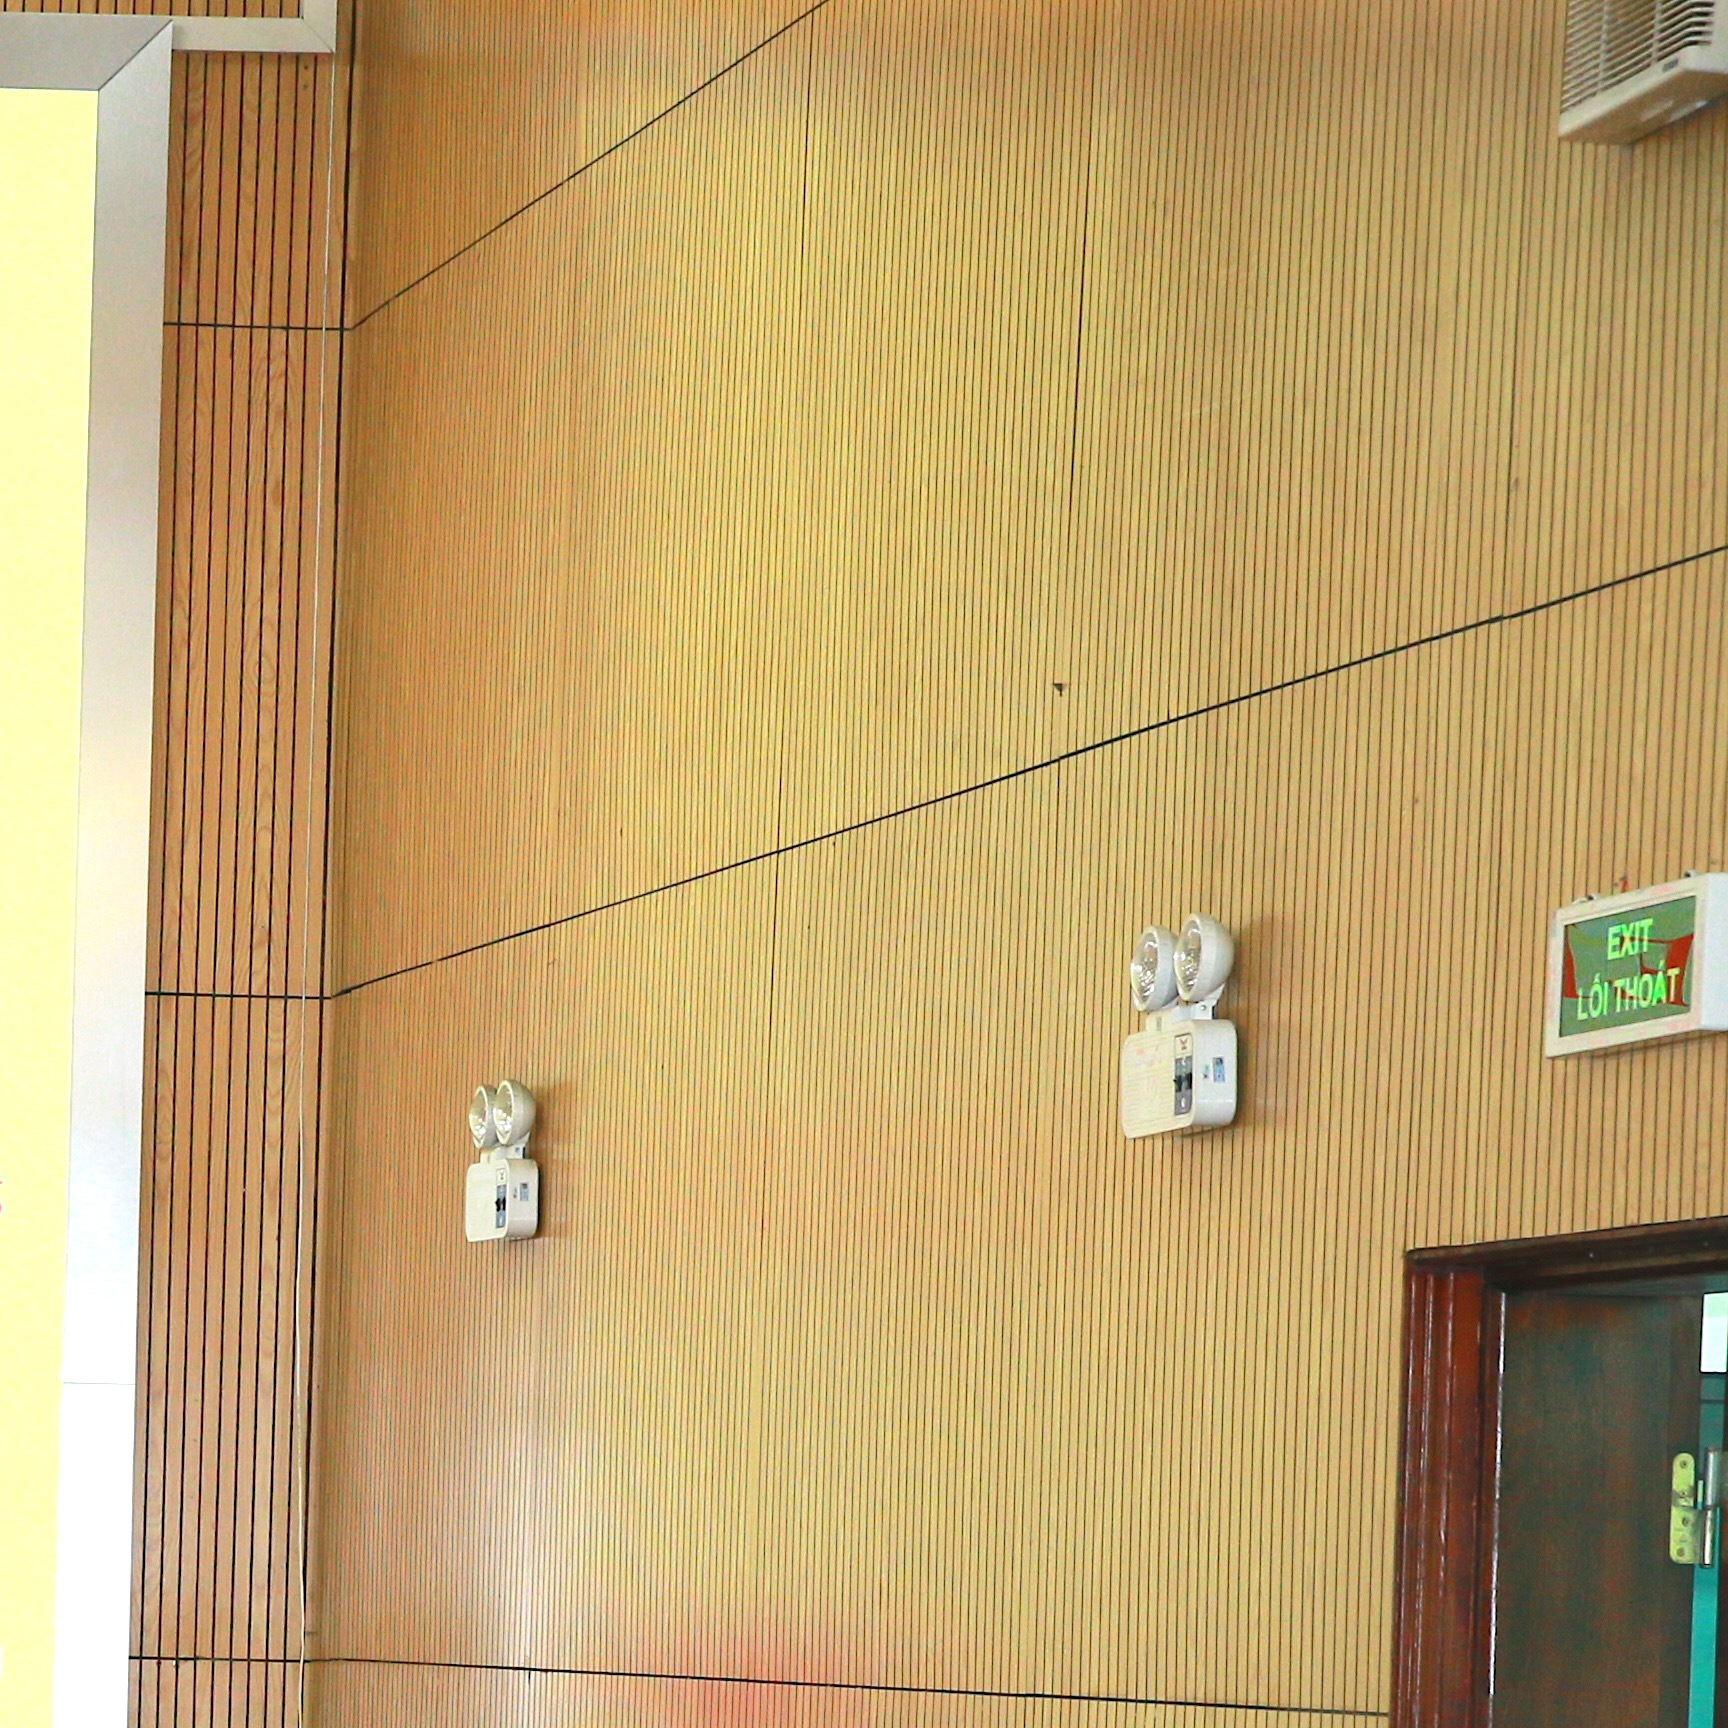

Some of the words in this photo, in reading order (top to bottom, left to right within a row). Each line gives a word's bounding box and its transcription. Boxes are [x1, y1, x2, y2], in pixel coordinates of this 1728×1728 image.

[1606, 917, 1654, 961] EXIT
[1576, 971, 1609, 1022] LỐI
[1612, 959, 1680, 1014] THOÁT
